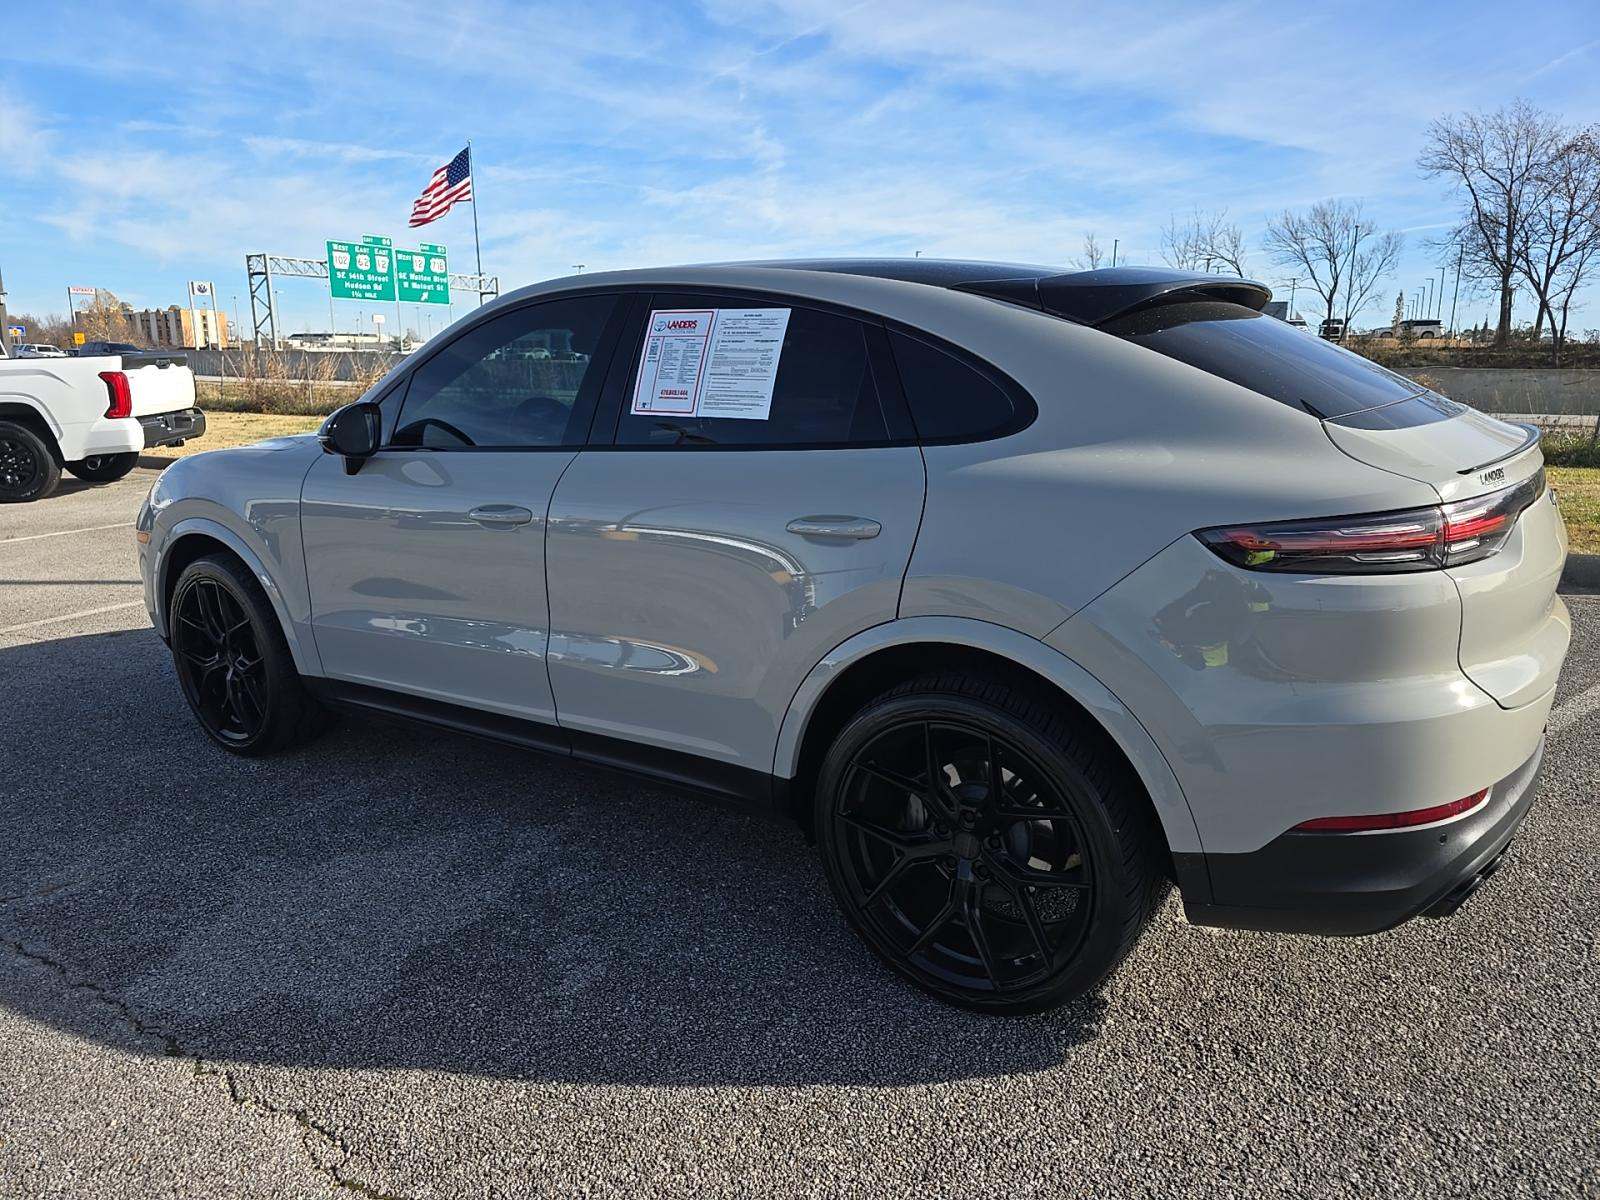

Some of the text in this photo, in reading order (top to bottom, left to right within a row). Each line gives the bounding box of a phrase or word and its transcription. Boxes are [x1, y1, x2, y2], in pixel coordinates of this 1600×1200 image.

[332, 243, 388, 255] WEST EAST EAST
[334, 255, 387, 269] 102 62 12
[415, 259, 423, 269] 12
[336, 271, 389, 282] SE 14th Street
[344, 281, 383, 291] Hudson Rd
[667, 320, 697, 329] LANDERS
[1479, 467, 1505, 485] LANDERS
